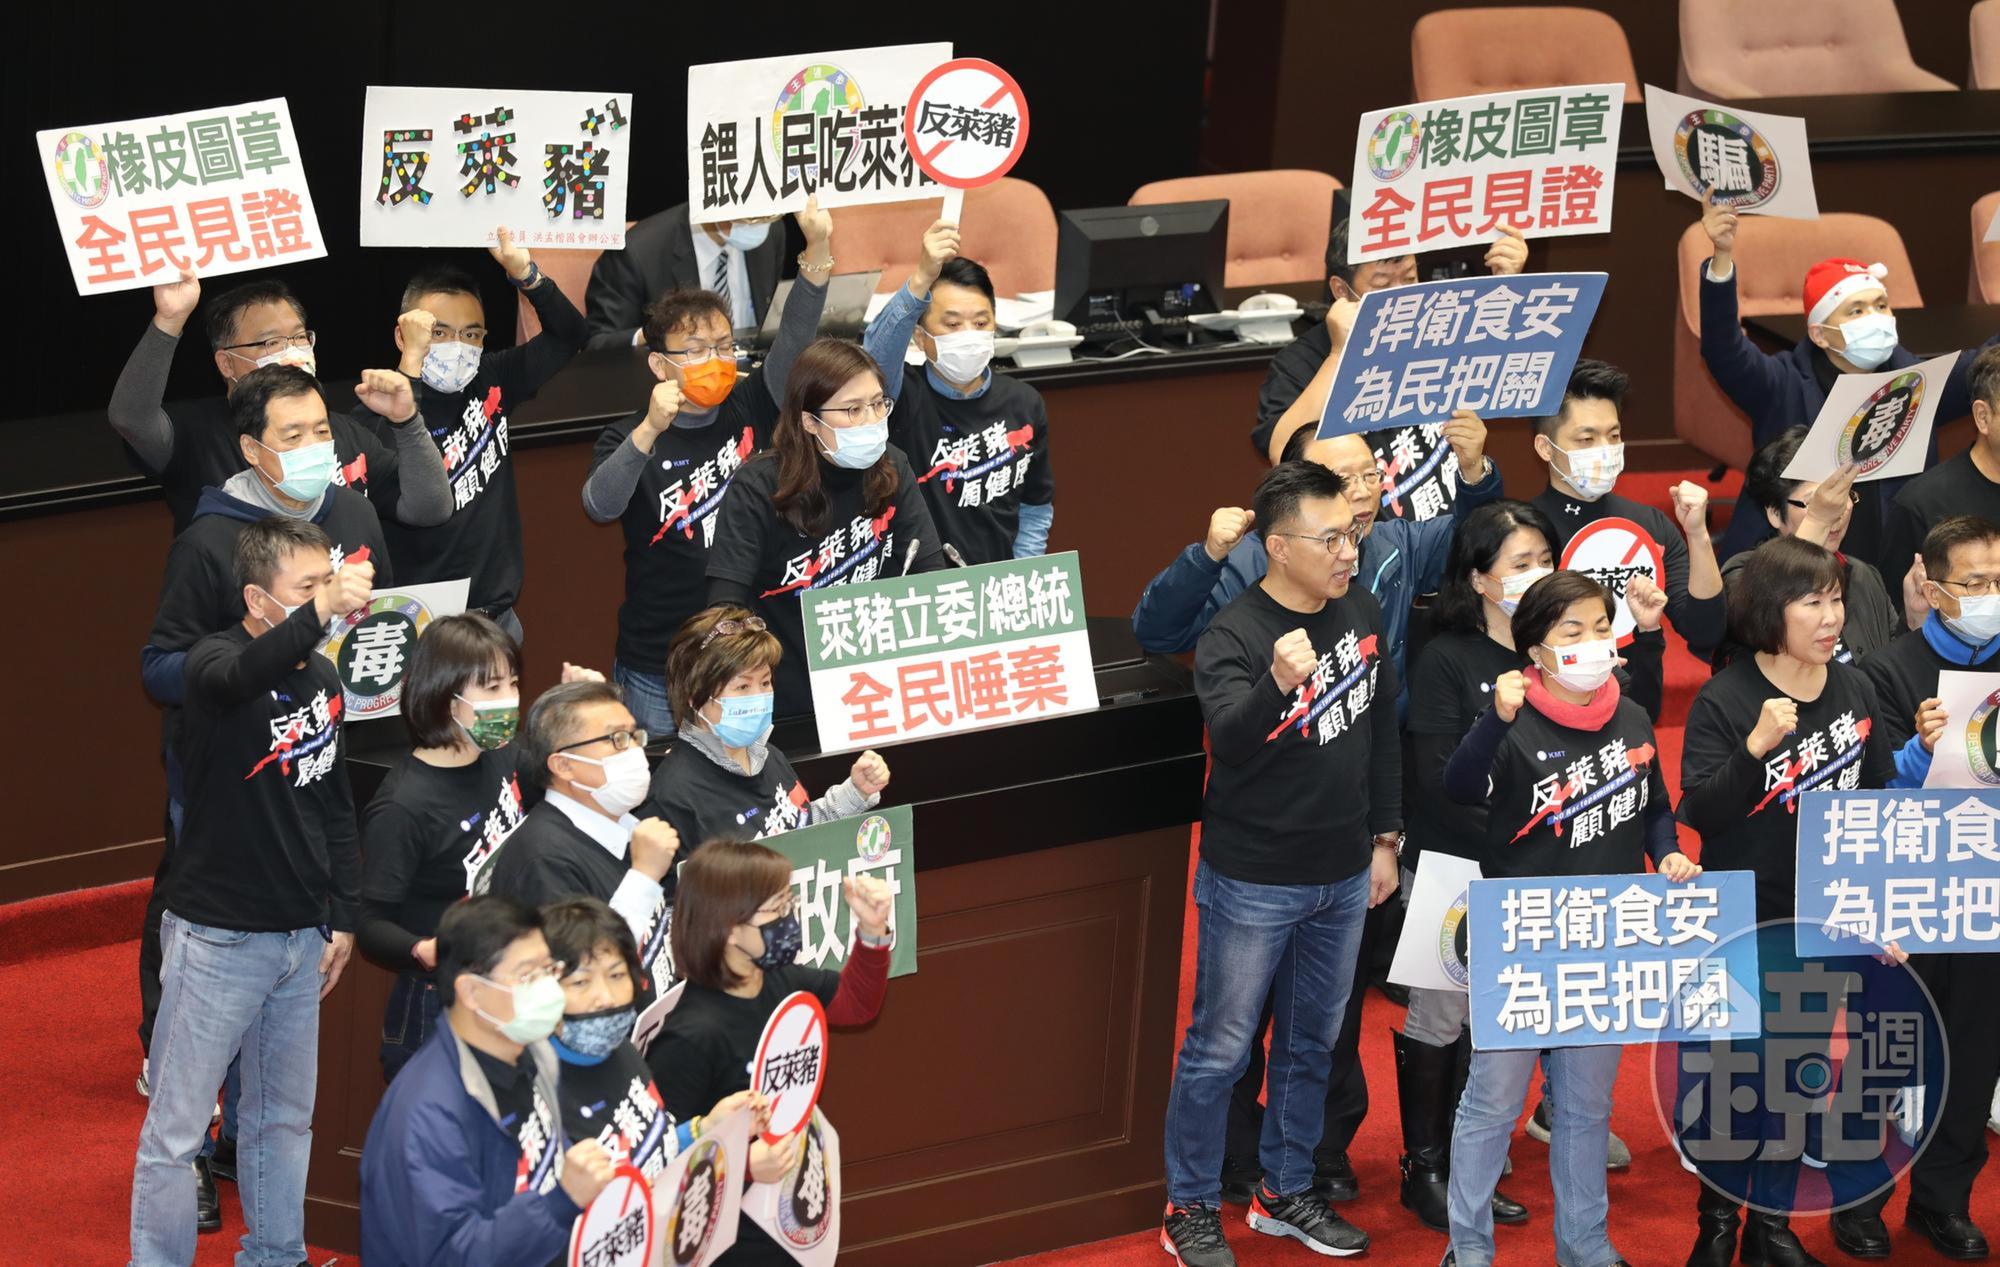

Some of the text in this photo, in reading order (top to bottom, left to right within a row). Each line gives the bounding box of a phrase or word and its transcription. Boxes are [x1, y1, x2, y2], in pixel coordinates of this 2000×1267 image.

[101, 110, 290, 197] 橡皮圖章
[916, 100, 1017, 149] 反萊豬
[1418, 93, 1610, 169] 橡皮圖章
[1697, 128, 1752, 192] 騙
[75, 188, 312, 285] 全民見證
[1361, 165, 1603, 254] 全民見證
[1363, 282, 1580, 357] 捍衛食安
[1342, 351, 1555, 424] 為民把關
[814, 566, 1074, 662] 萊豬立委/總統
[349, 620, 409, 686] 毒
[841, 645, 1069, 741] 全民唾棄
[1530, 738, 1631, 815] 反萊豬
[1549, 750, 1566, 759] KMT
[1764, 710, 1861, 792] 反萊豬
[1501, 883, 1719, 951] 捍衛食安
[1496, 957, 1729, 1036] 為民把關
[761, 1044, 820, 1096] 反萊豬
